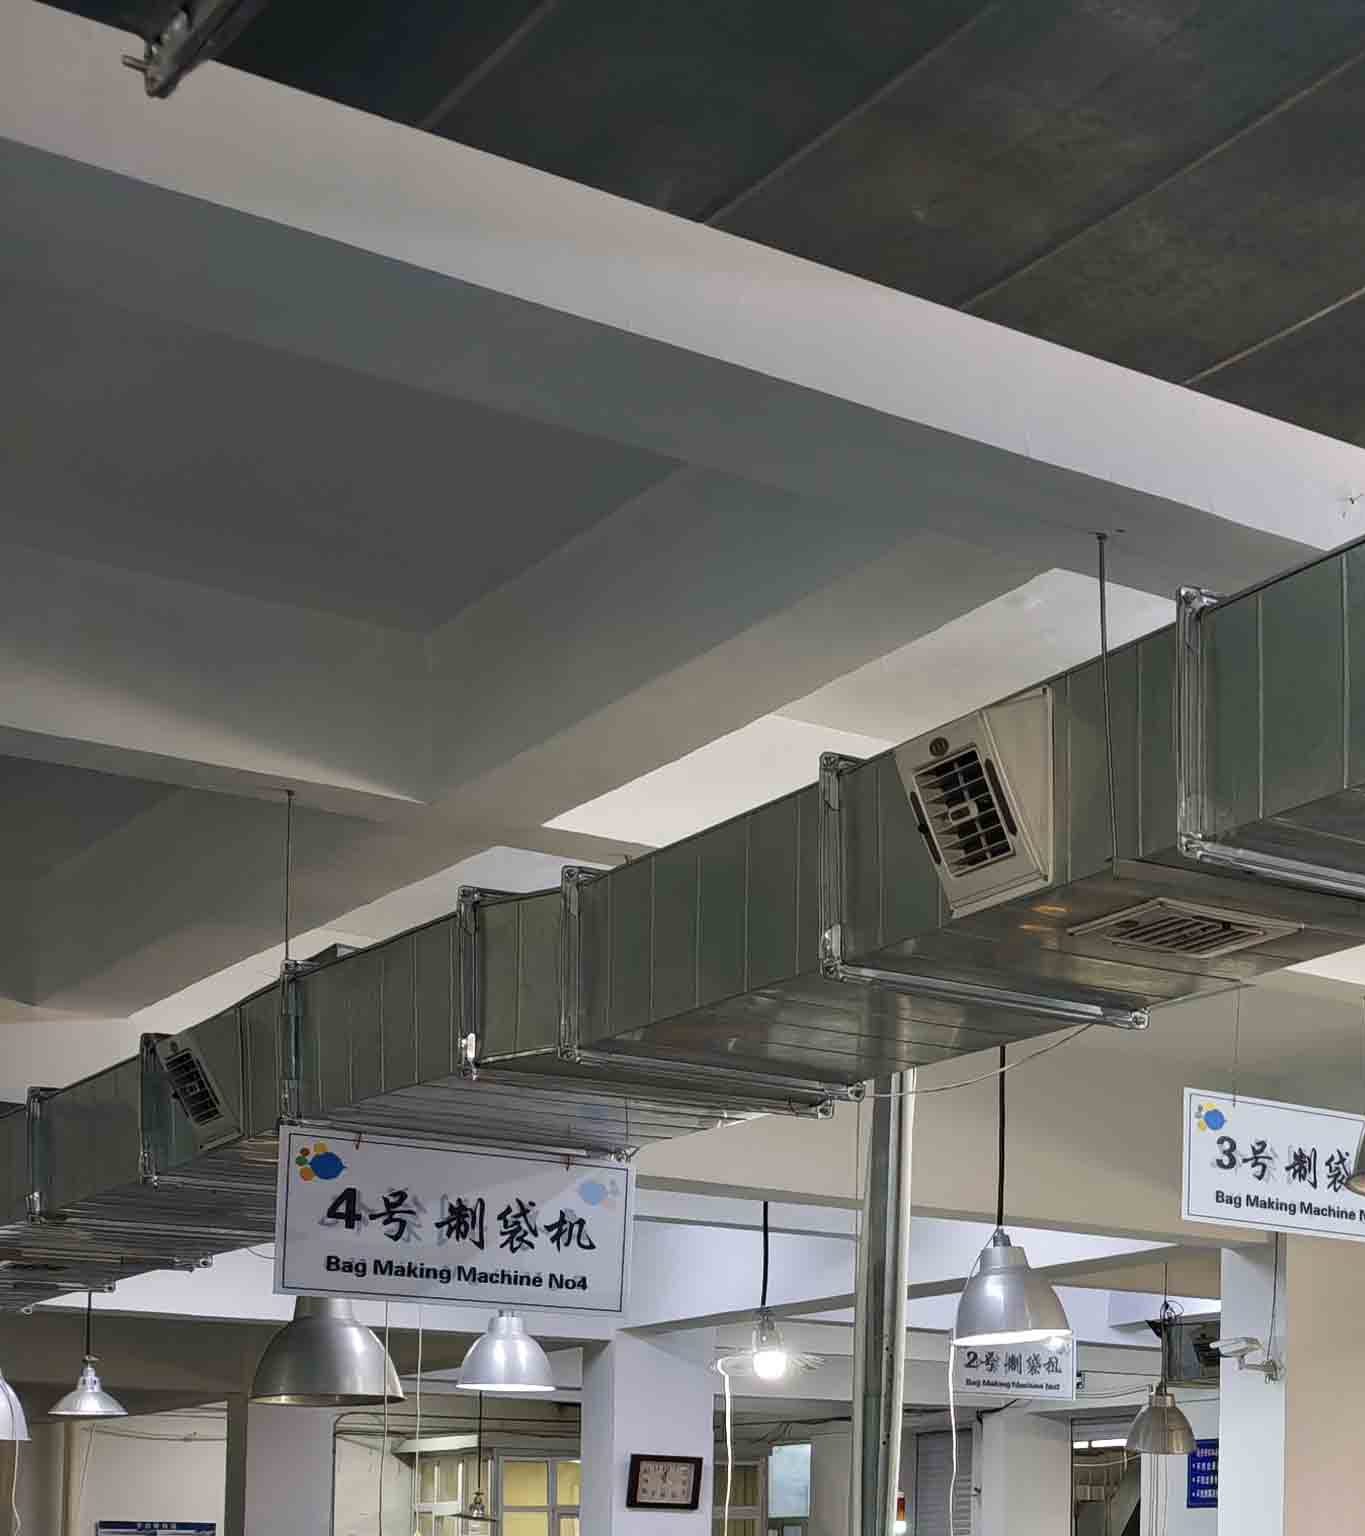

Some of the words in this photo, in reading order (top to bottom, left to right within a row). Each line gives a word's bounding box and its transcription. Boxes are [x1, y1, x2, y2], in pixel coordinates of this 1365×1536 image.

[1216, 1135, 1351, 1192] 3号制袋
[1215, 1190, 1242, 1209] Bag
[1246, 1194, 1297, 1216] Making
[1300, 1200, 1356, 1221] Machine
[326, 1255, 367, 1277] Bag
[373, 1259, 451, 1284] Making
[457, 1265, 543, 1288] Machine
[549, 1273, 588, 1290] No4
